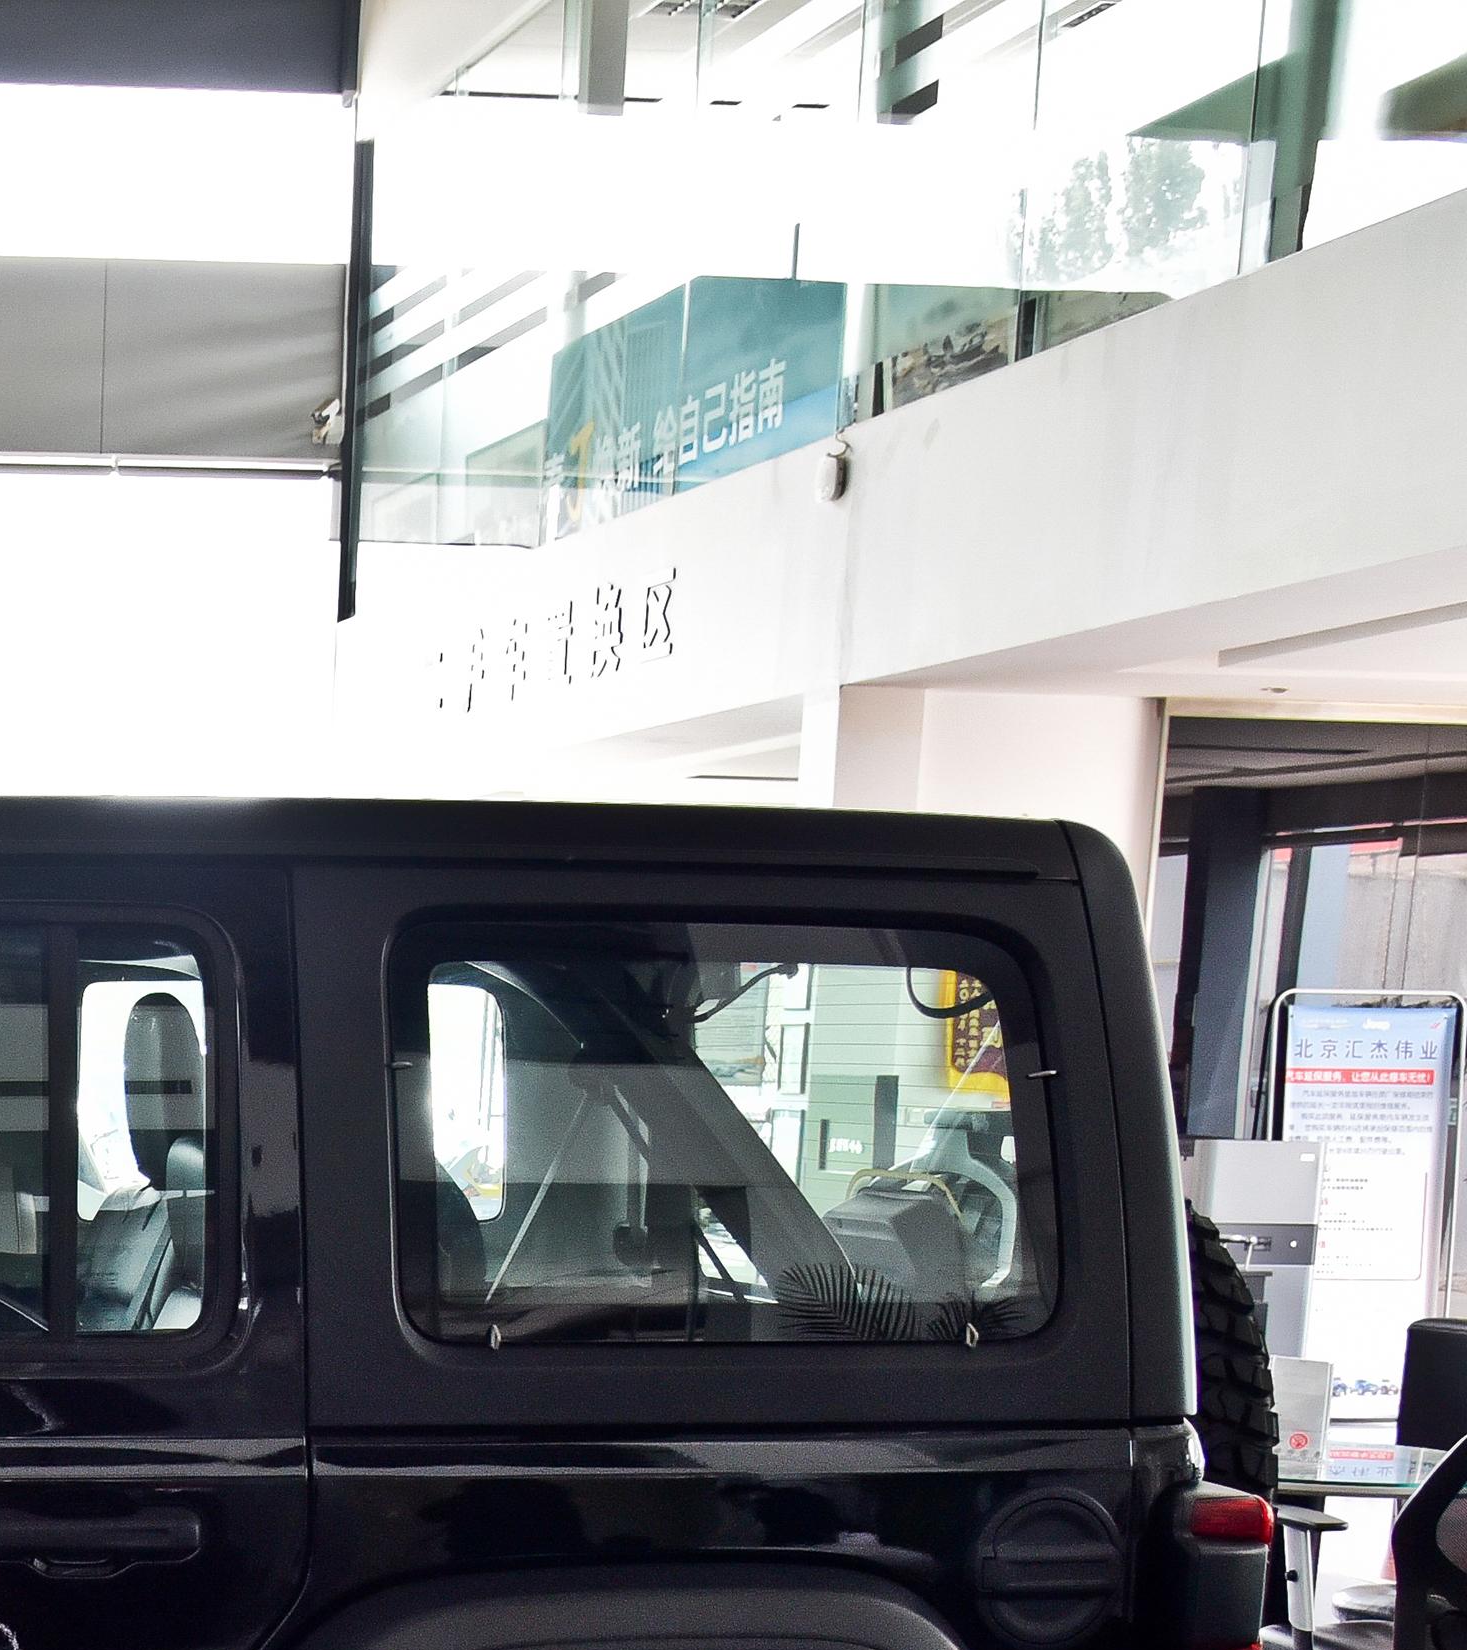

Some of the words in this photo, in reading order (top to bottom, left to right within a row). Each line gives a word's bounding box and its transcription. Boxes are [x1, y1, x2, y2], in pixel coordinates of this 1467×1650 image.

[653, 358, 786, 478] 给自己指南
[1294, 1039, 1438, 1060] 北京汇杰伟业
